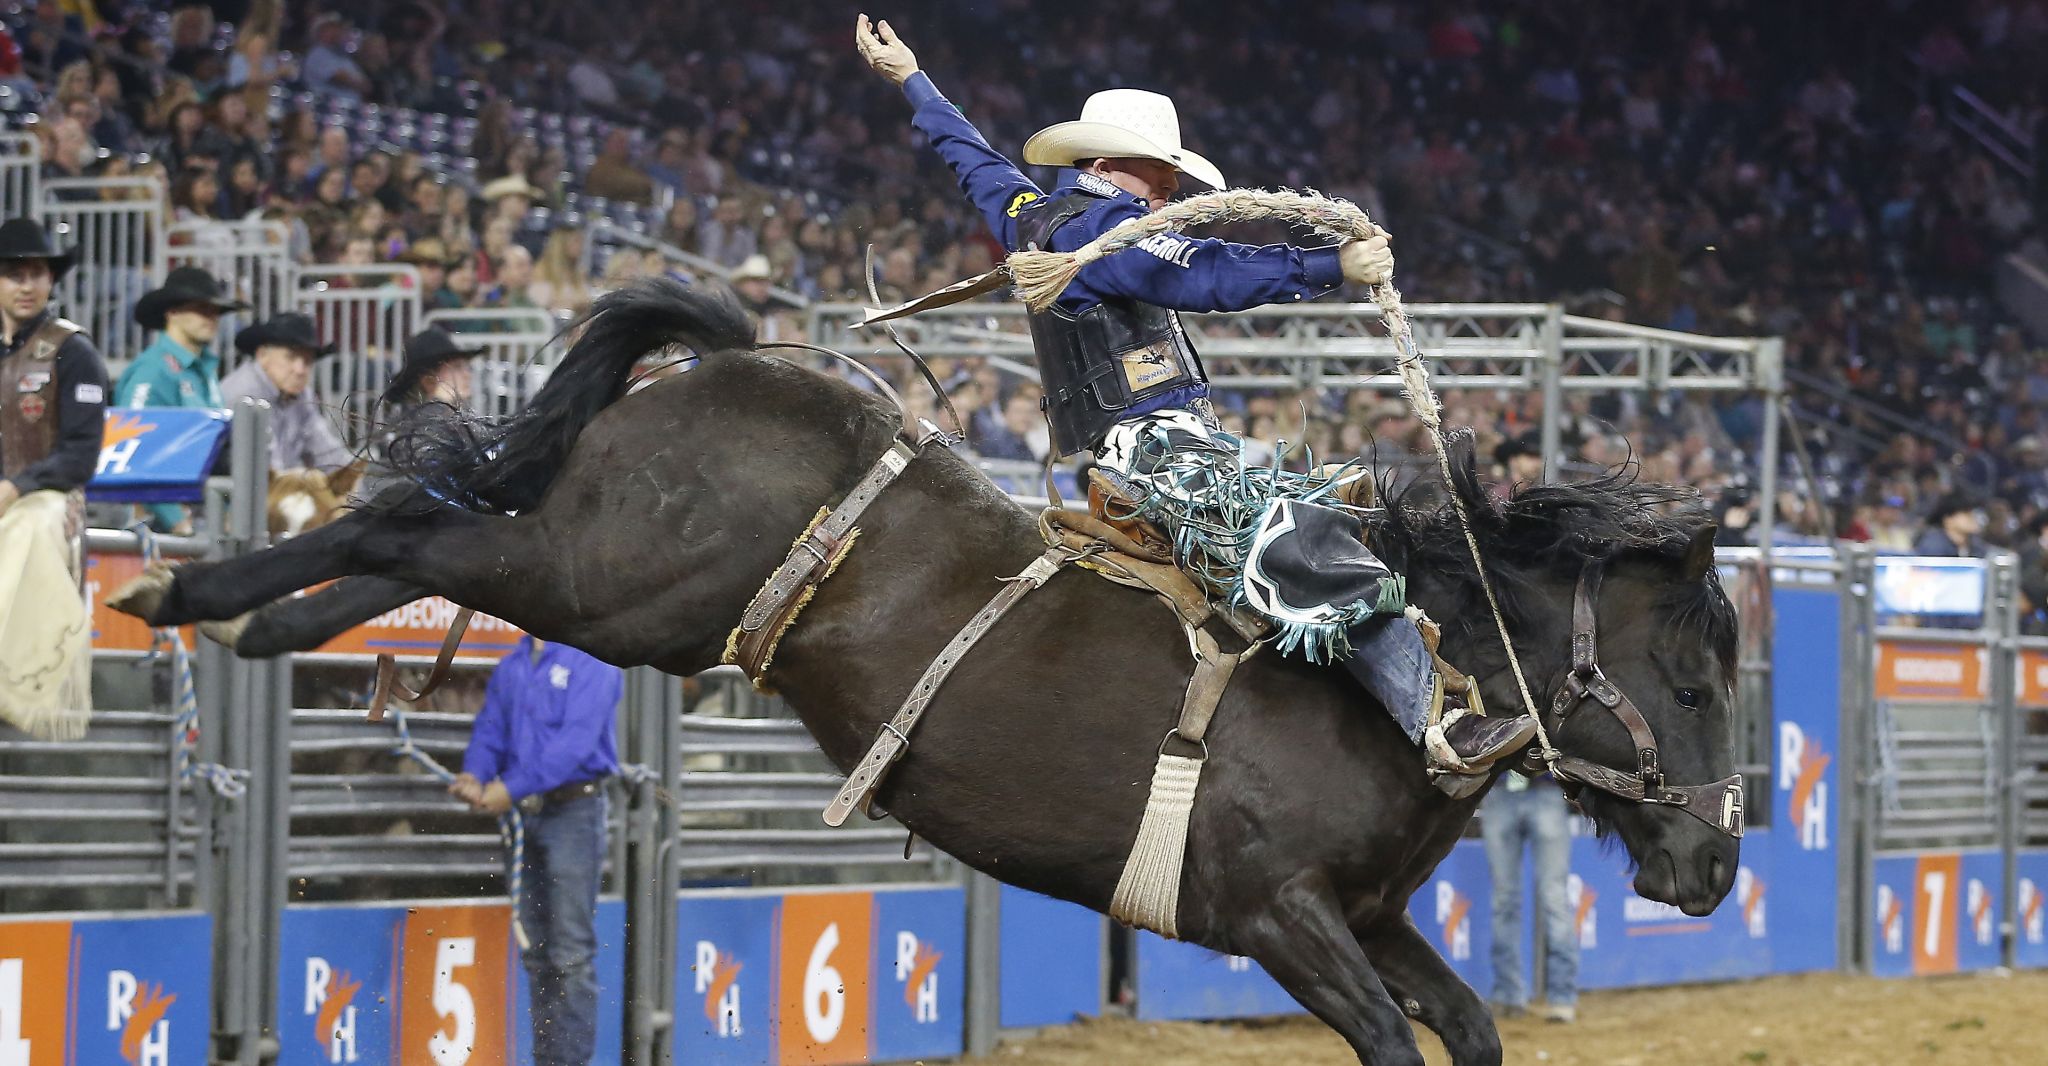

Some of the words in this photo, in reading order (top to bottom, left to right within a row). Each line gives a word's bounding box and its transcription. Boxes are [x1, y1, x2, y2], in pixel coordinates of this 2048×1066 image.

[1076, 172, 1123, 199] PANHANDLE
[96, 438, 141, 475] H
[428, 936, 476, 1066] 5
[803, 922, 845, 1043] 6
